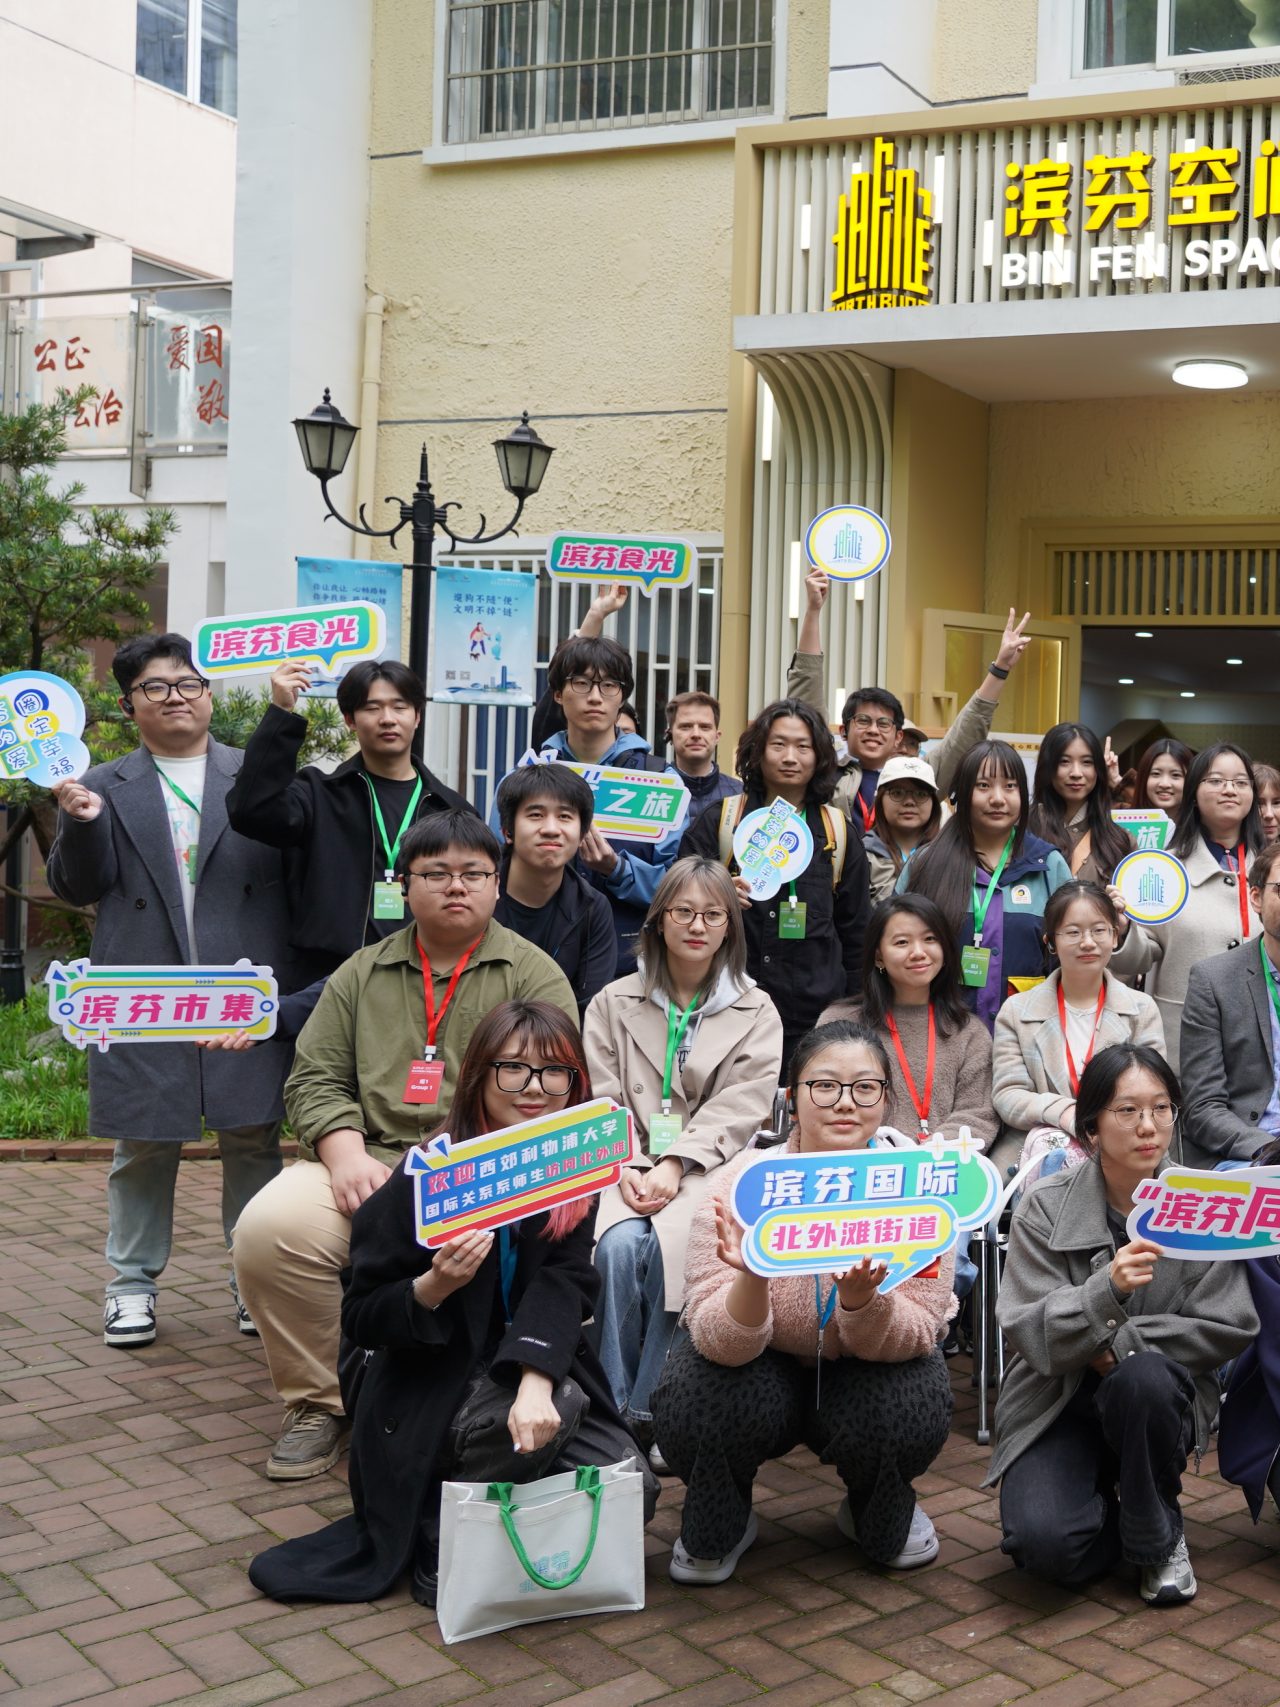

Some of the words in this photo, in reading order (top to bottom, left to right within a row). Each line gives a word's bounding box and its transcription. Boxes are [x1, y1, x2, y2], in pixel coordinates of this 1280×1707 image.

[1001, 249, 1075, 288] BIN
[1089, 241, 1168, 284] FEN
[826, 294, 877, 311] ORTH
[880, 293, 930, 308] BUN
[166, 324, 223, 371] 爱国
[559, 544, 675, 572] 滨芬食光
[210, 617, 357, 660] 滨芬食光
[589, 783, 675, 819] 之旅
[78, 993, 256, 1025] 滨芬市集
[427, 1118, 618, 1196] 欢迎西郊利物浦大学
[425, 1140, 626, 1220] 国际关系系师生访问北外滩
[760, 1160, 960, 1208] 滨芬国际
[771, 1215, 938, 1252] 北外滩街道
